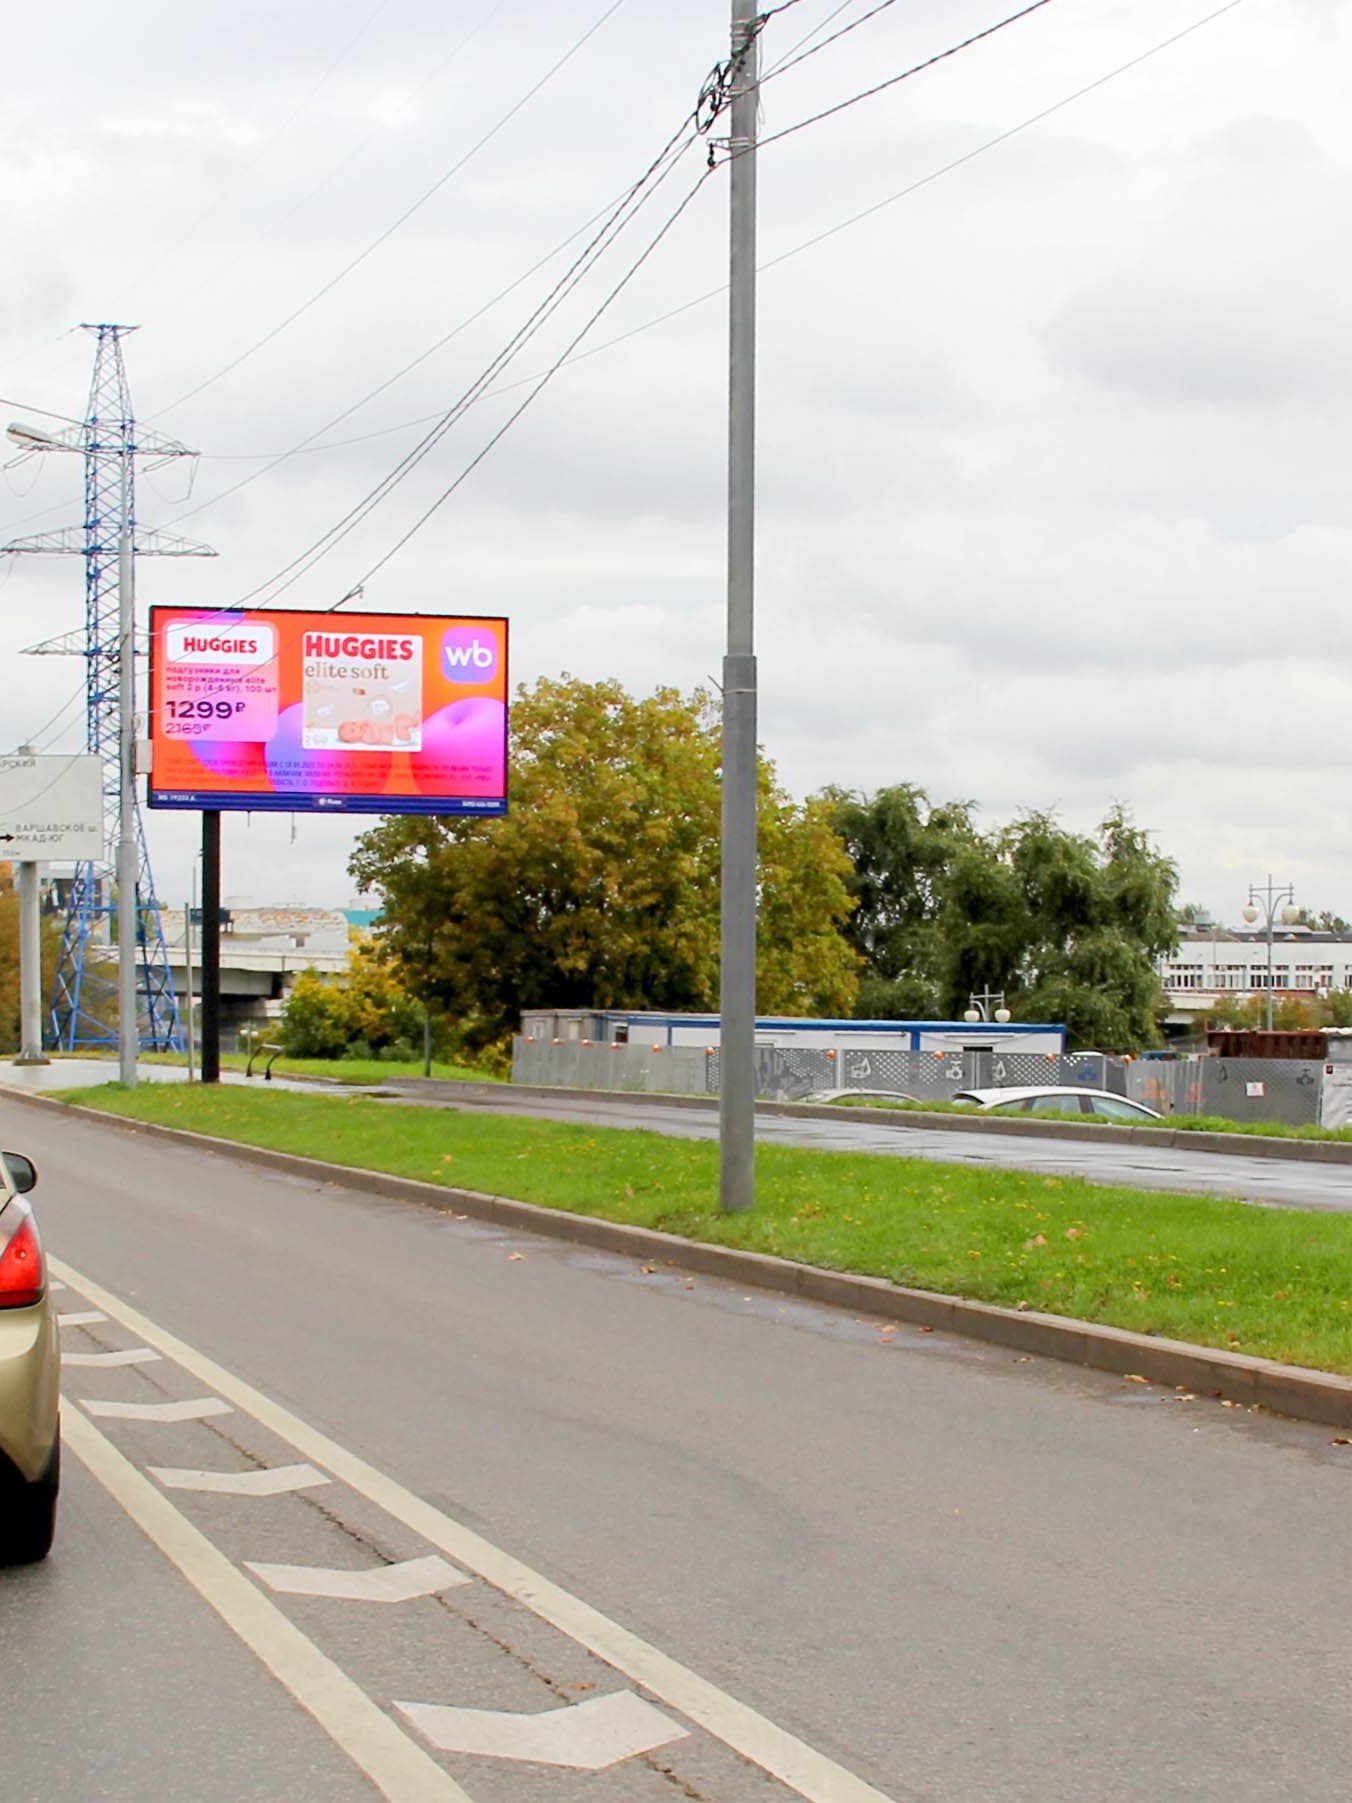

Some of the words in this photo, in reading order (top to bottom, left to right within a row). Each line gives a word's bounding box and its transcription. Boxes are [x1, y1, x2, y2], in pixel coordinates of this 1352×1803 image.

[183, 637, 258, 653] HUGGIES
[305, 635, 413, 661] HUGGIES
[445, 640, 493, 668] wb
[305, 662, 347, 679] elite
[351, 663, 389, 680] soft
[15, 824, 85, 833] ВАРШАВСКОЕ
